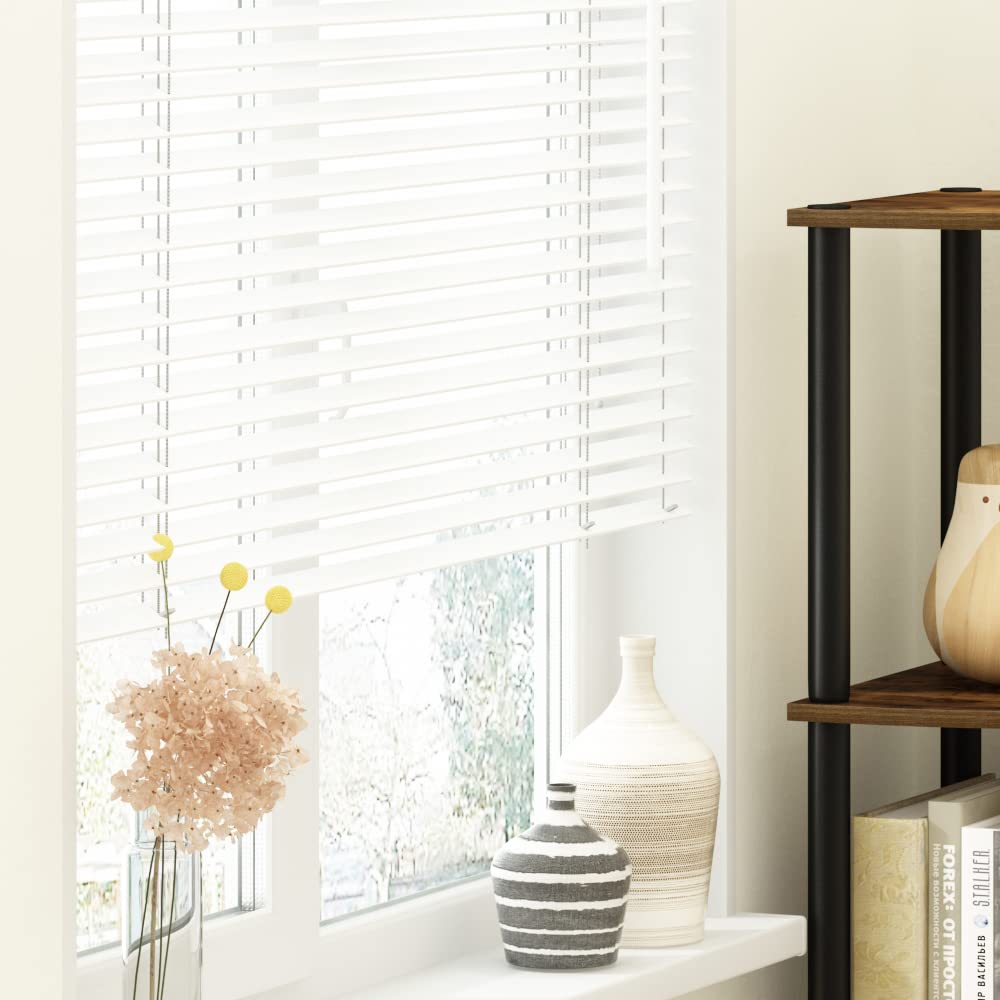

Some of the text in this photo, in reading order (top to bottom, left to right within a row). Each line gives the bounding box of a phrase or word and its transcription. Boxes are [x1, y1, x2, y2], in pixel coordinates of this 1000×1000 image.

[943, 844, 956, 911] FOREX:
[943, 918, 956, 941] ОТ
[977, 935, 986, 986] ВАСИЛЬЕВ
